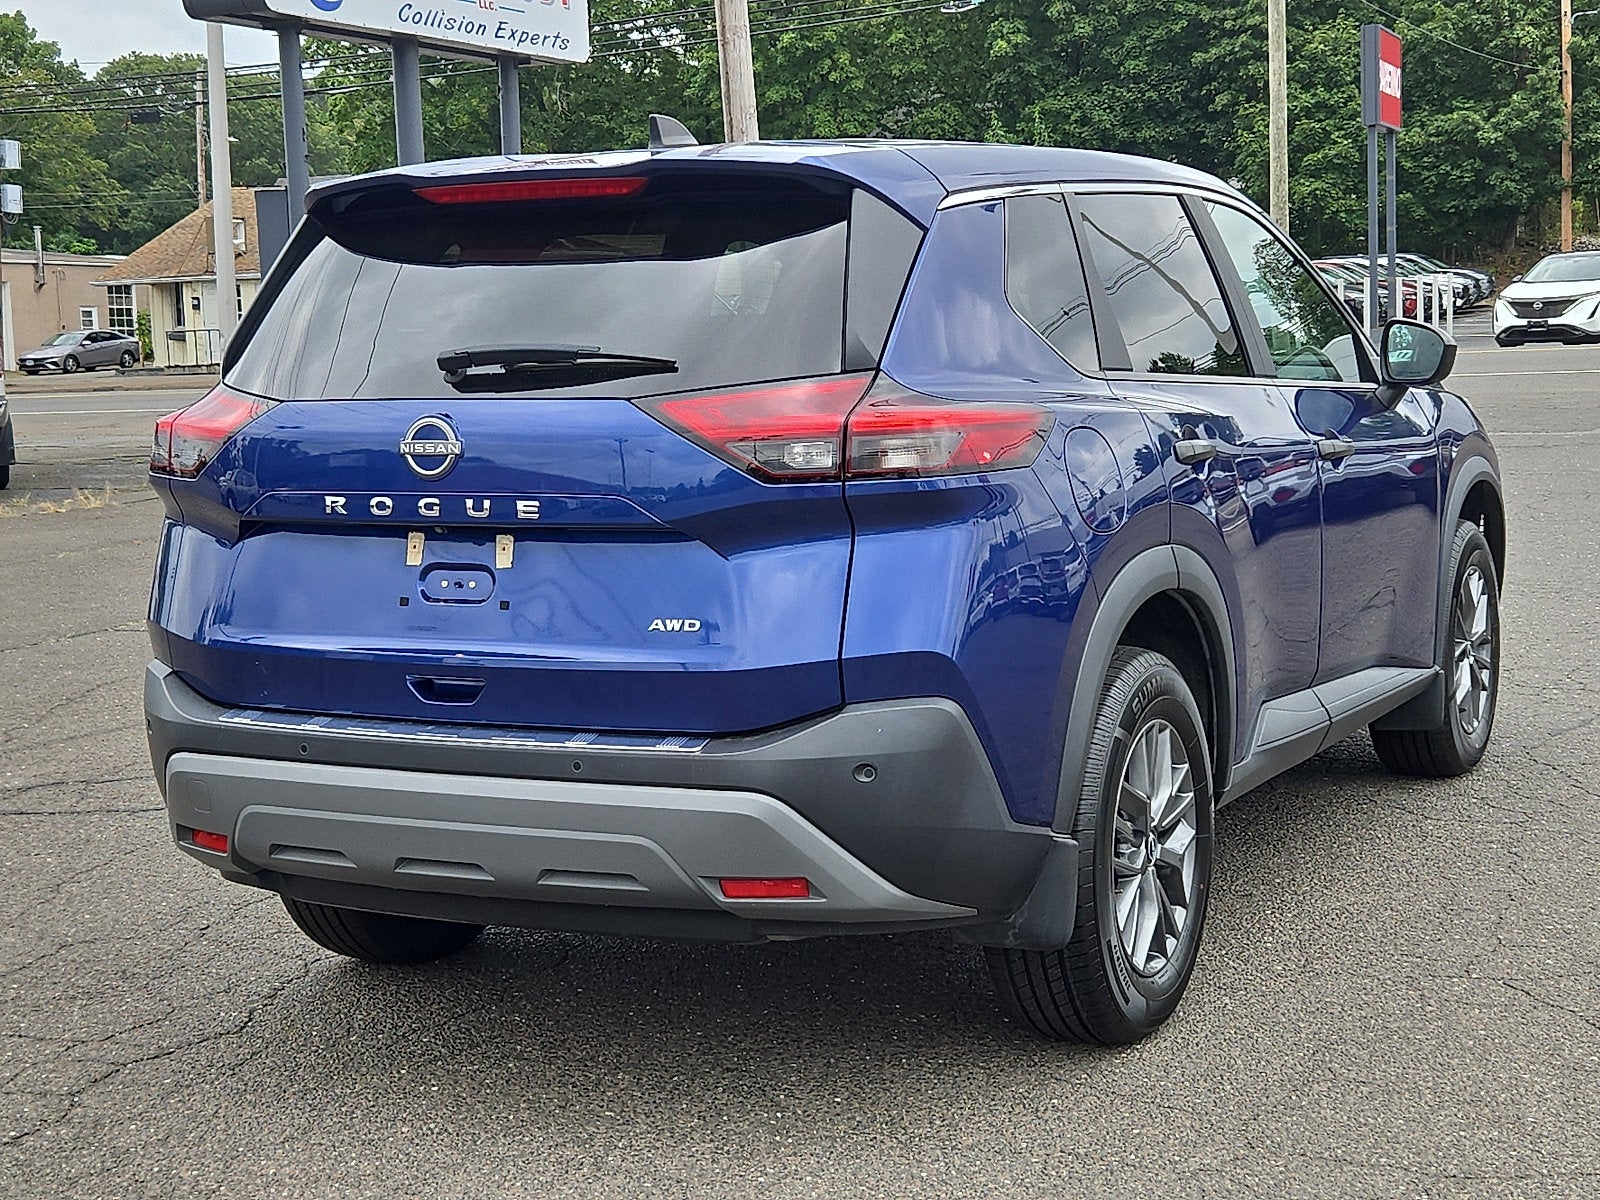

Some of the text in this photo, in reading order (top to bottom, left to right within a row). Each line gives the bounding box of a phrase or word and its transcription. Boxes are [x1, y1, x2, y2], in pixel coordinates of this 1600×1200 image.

[478, 0, 498, 11] LLC.
[398, 3, 570, 50] Collision Experts
[400, 443, 459, 454] NISSAN
[324, 495, 541, 519] ROGUE
[647, 618, 702, 632] AWD
